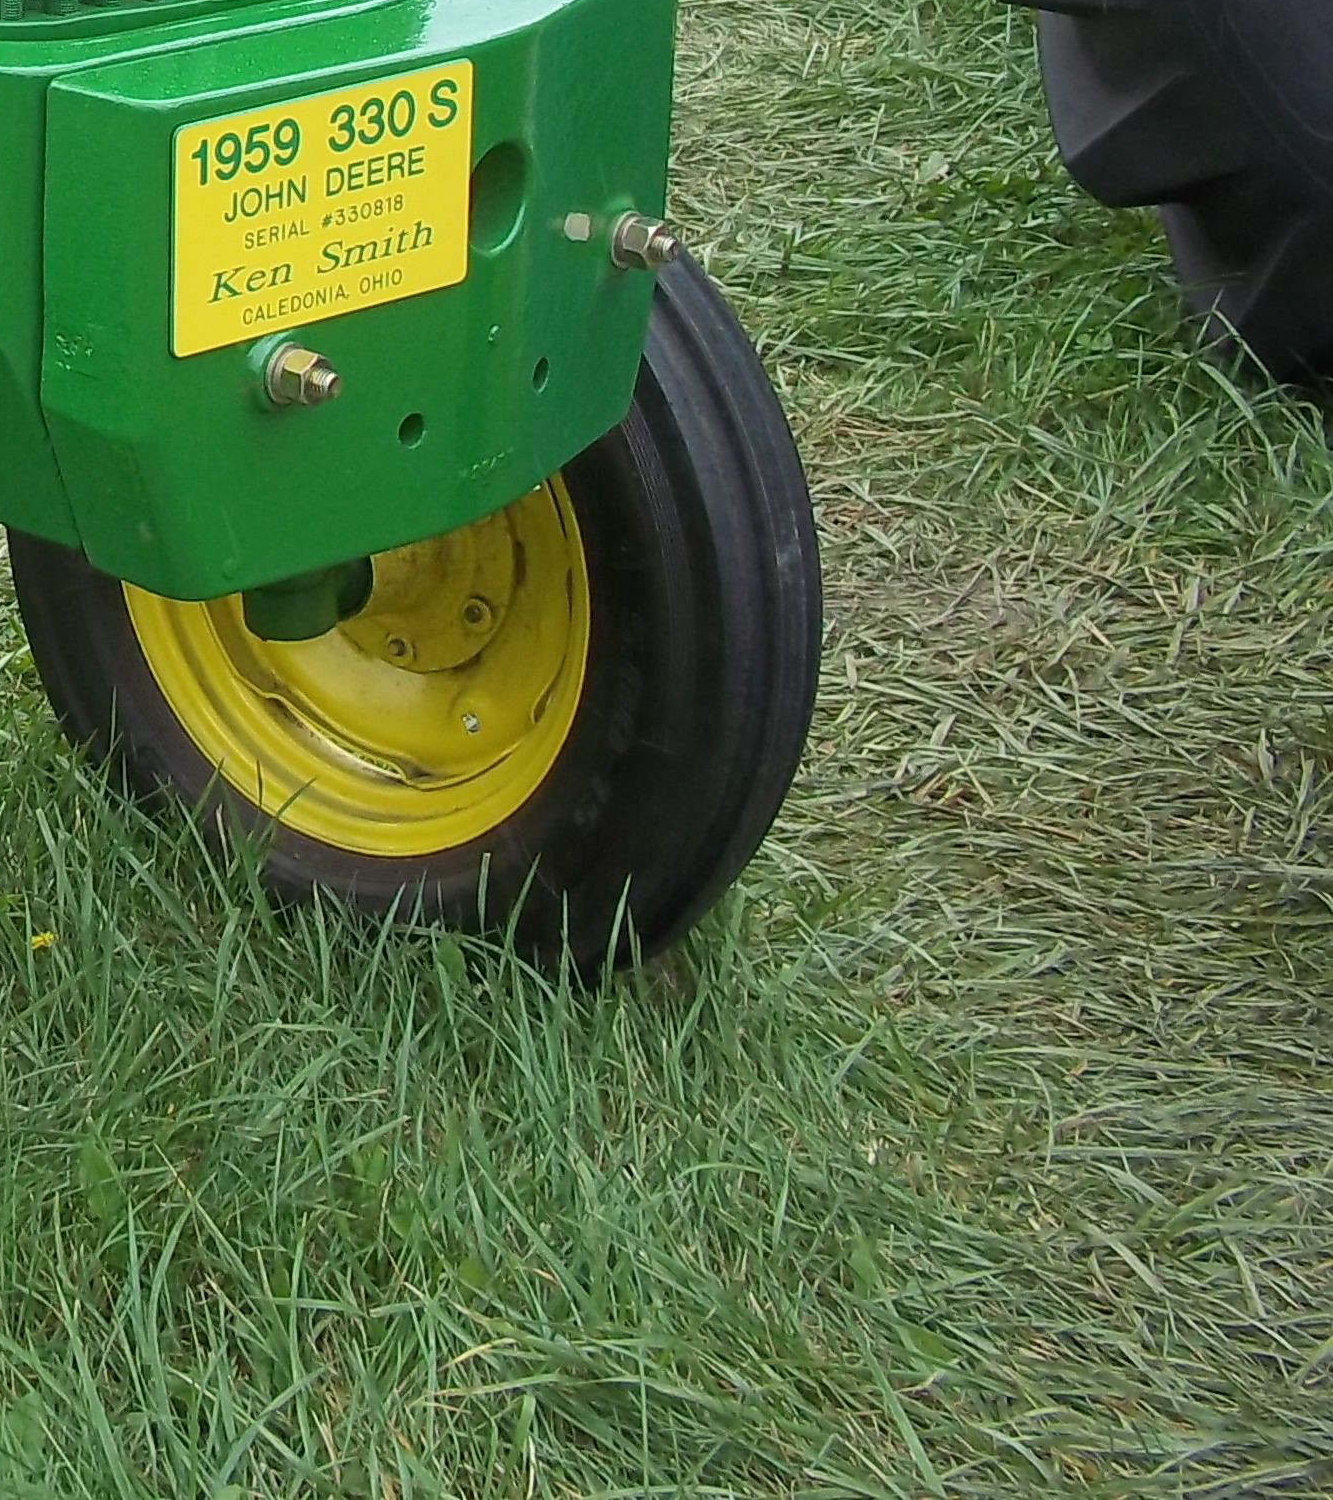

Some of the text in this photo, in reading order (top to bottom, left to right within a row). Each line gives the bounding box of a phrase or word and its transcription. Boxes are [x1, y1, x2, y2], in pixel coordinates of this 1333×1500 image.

[191, 78, 459, 187] 1959 330 S
[224, 146, 425, 223] JOHN DEERE
[244, 194, 404, 250] SERIAL #330818
[207, 220, 434, 304] Ken Smith
[242, 268, 404, 326] CALEDONIA, OHIO
